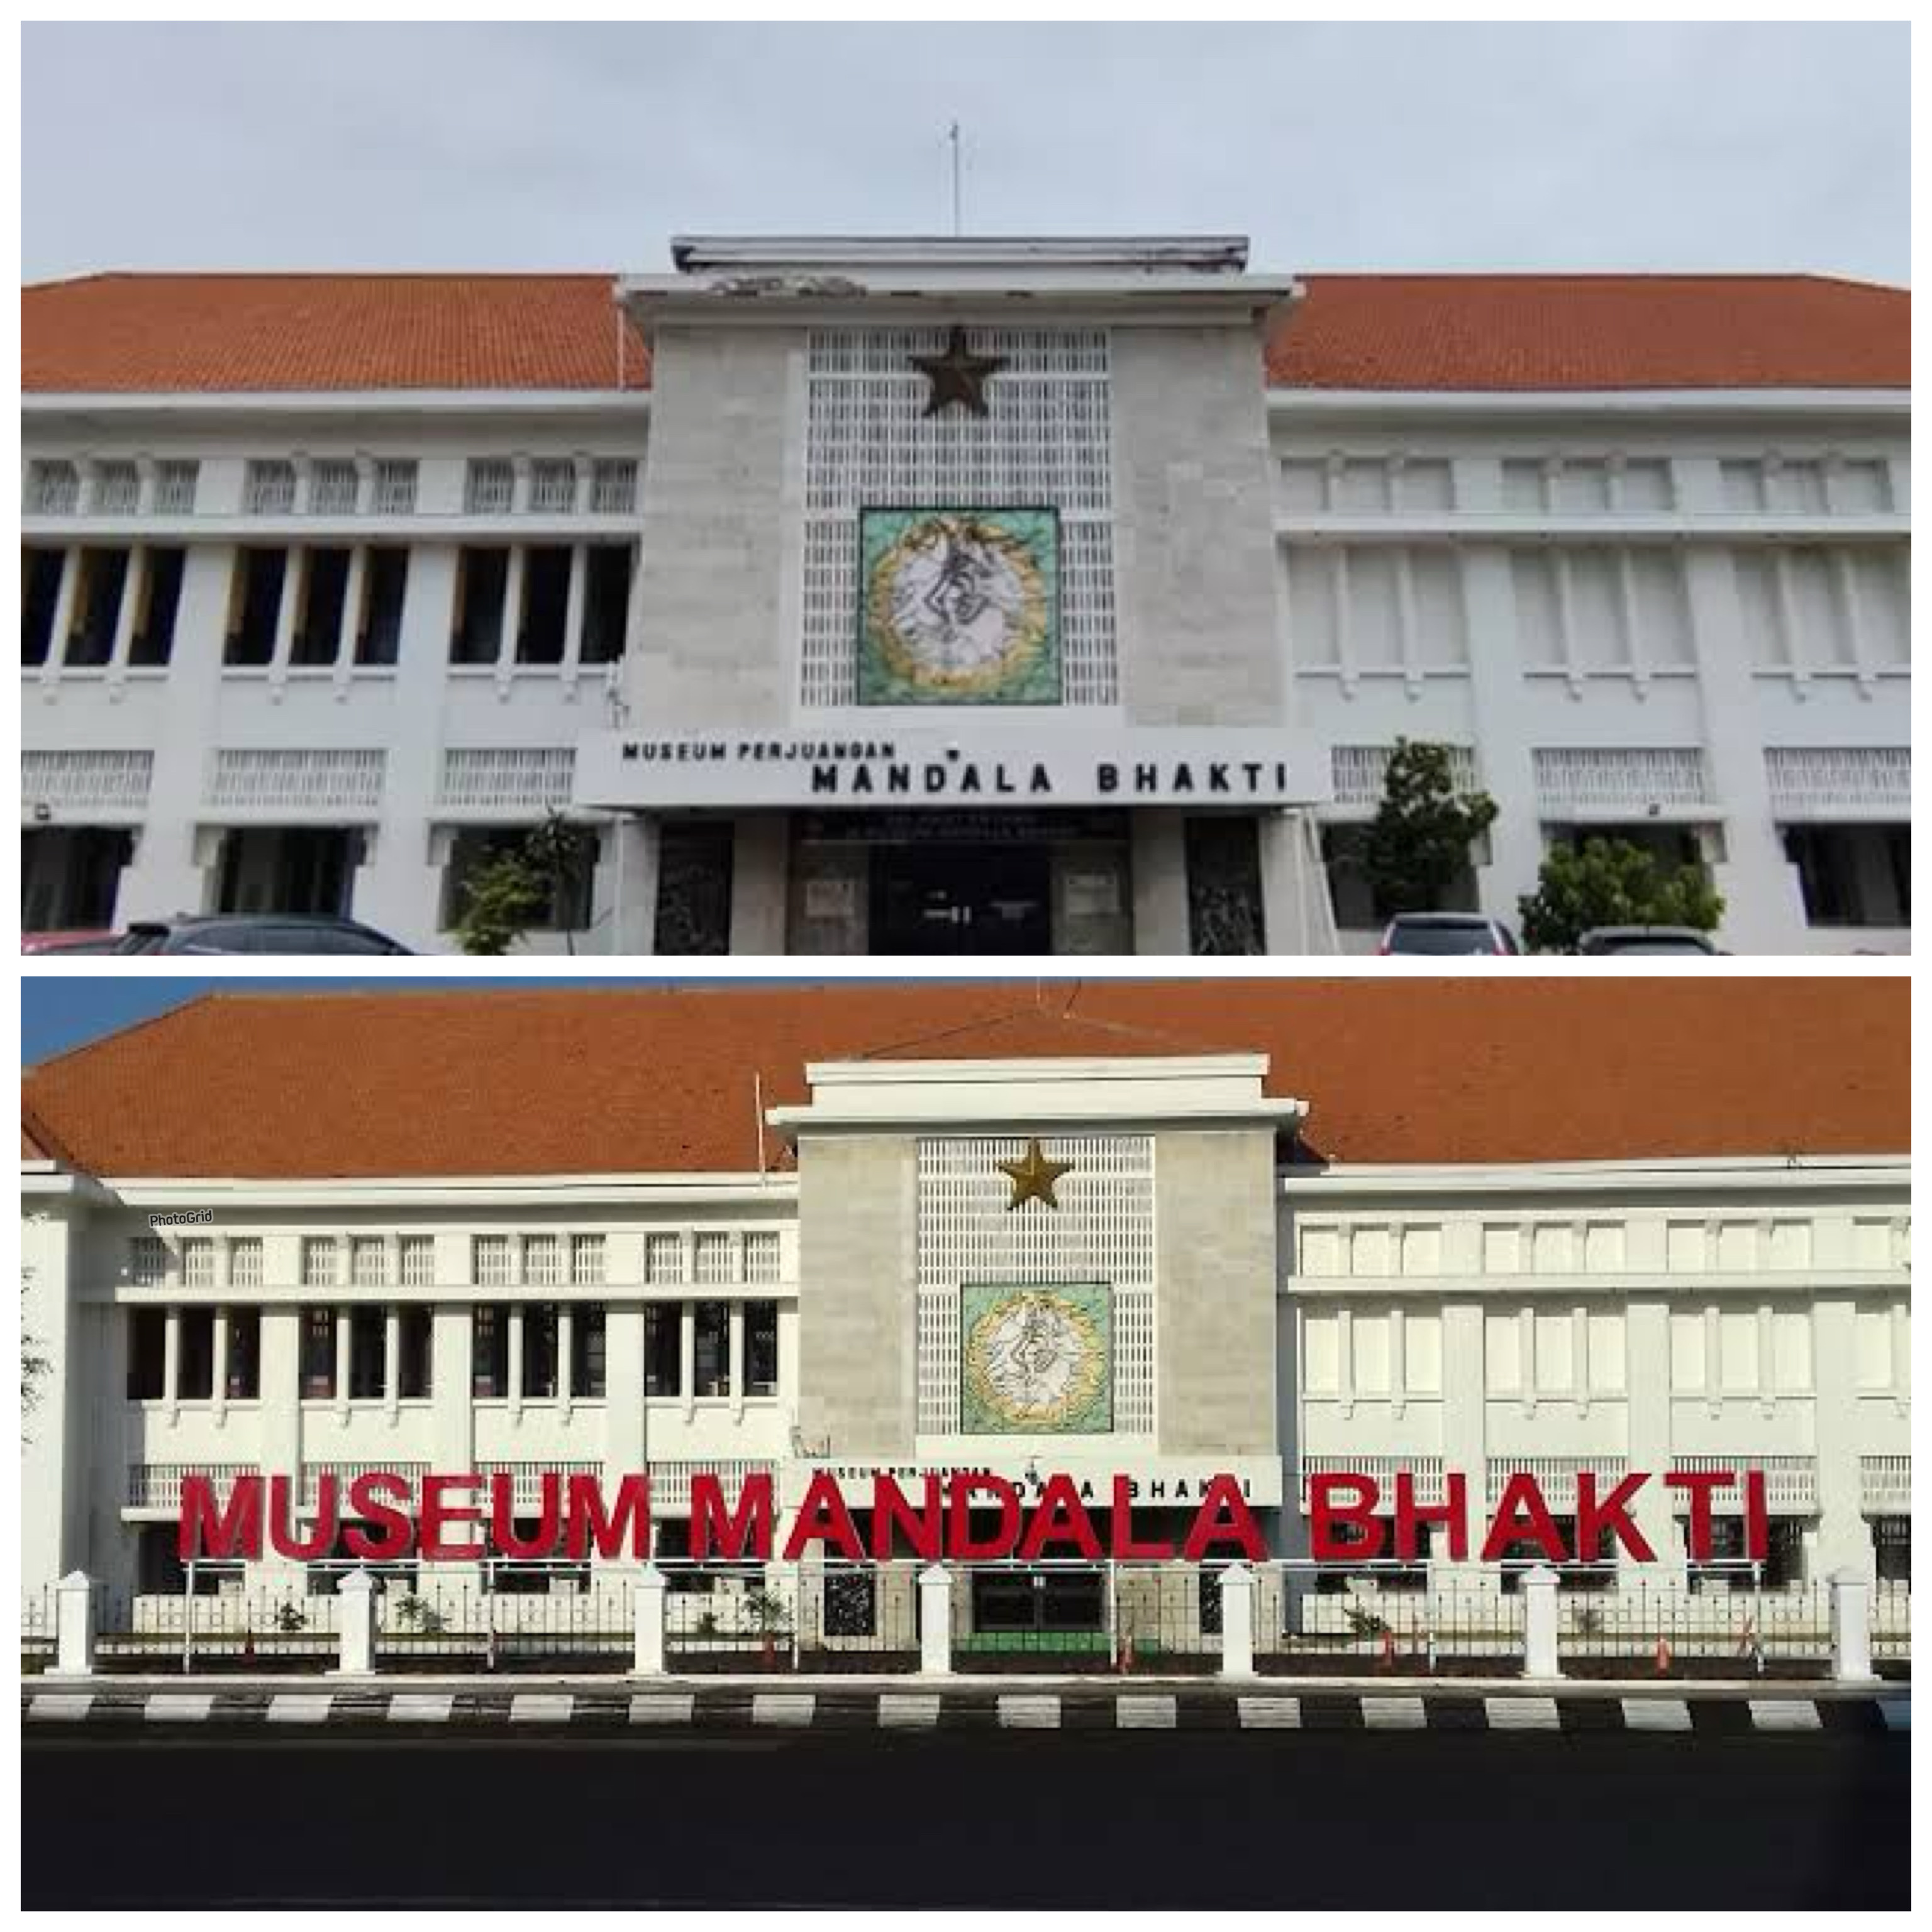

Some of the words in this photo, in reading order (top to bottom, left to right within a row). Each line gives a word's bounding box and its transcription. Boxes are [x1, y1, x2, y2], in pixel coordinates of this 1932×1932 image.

[623, 741, 726, 761] MUSEUM
[738, 741, 895, 760] PERJUANGAN
[812, 763, 1052, 793] MANDALA
[1097, 763, 1287, 792] BHAKTI
[177, 1472, 652, 1562] MUSEUM
[689, 1470, 1269, 1563] MANDALA
[1308, 1470, 1768, 1562] BHAKTI
